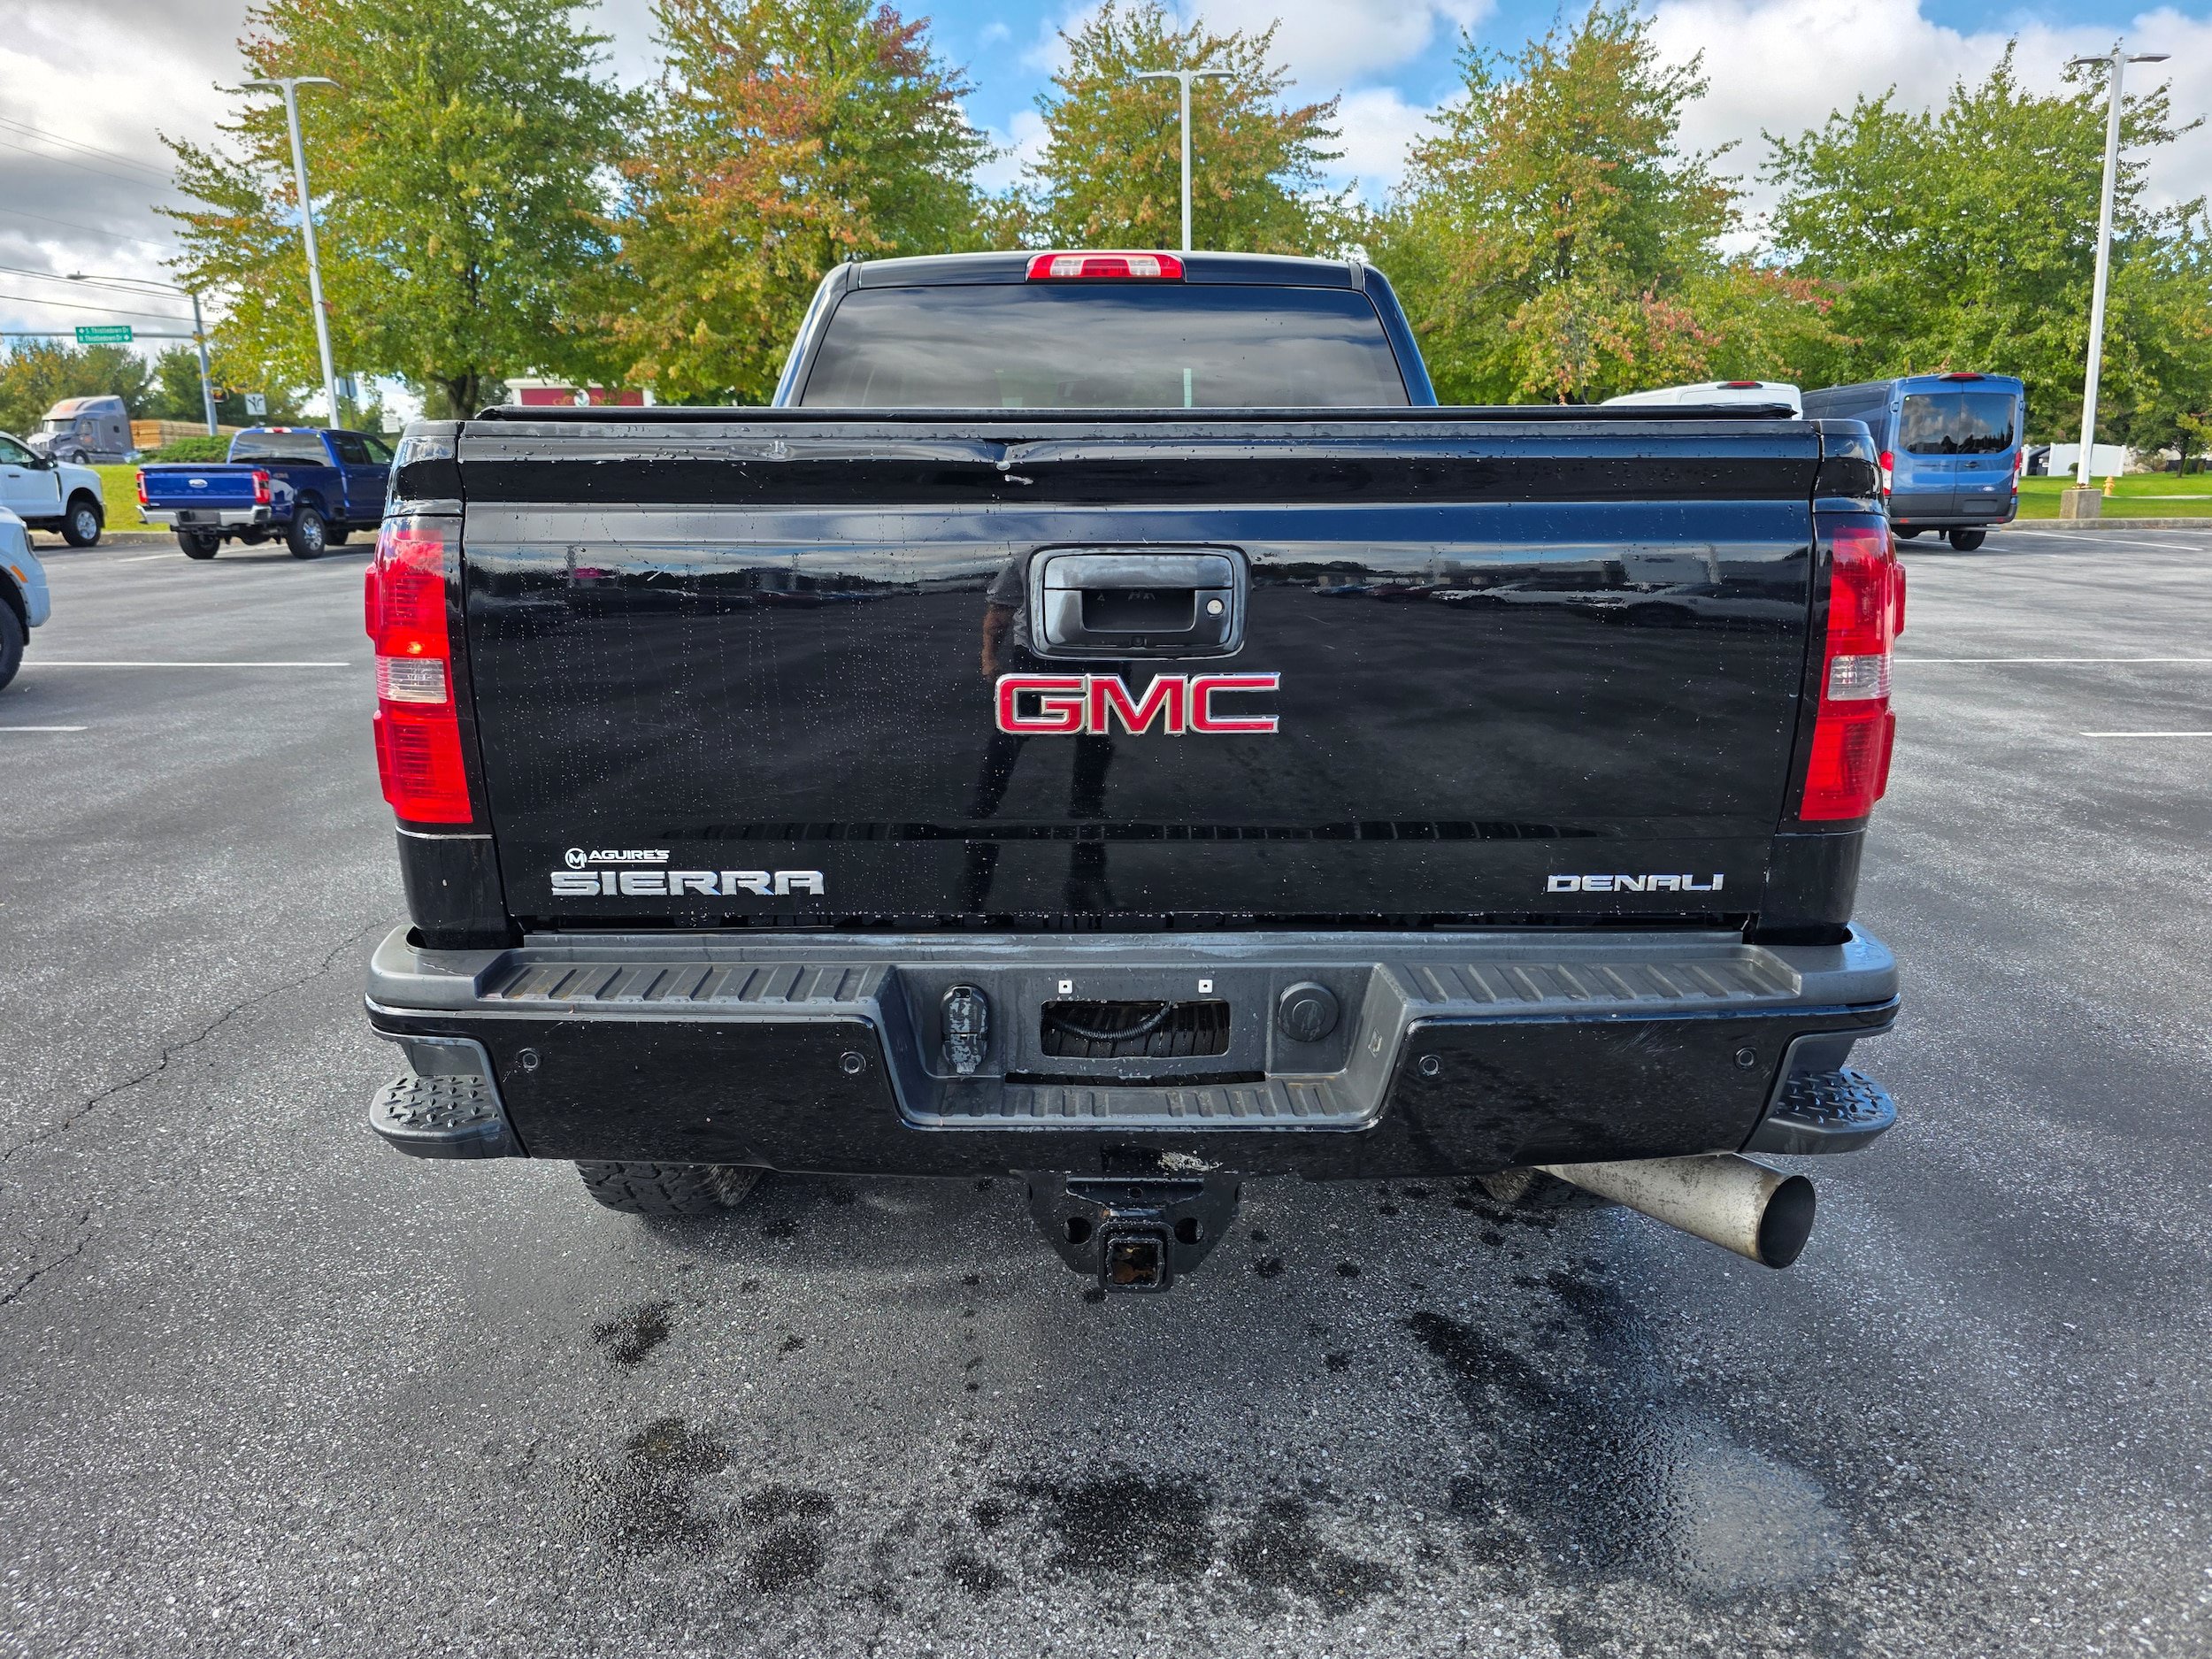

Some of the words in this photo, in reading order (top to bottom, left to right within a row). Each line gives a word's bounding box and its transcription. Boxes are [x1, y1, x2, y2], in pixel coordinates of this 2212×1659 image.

[995, 672, 1281, 736] GMC
[550, 871, 825, 896] SIERRA
[1547, 873, 1724, 893] DENALI
